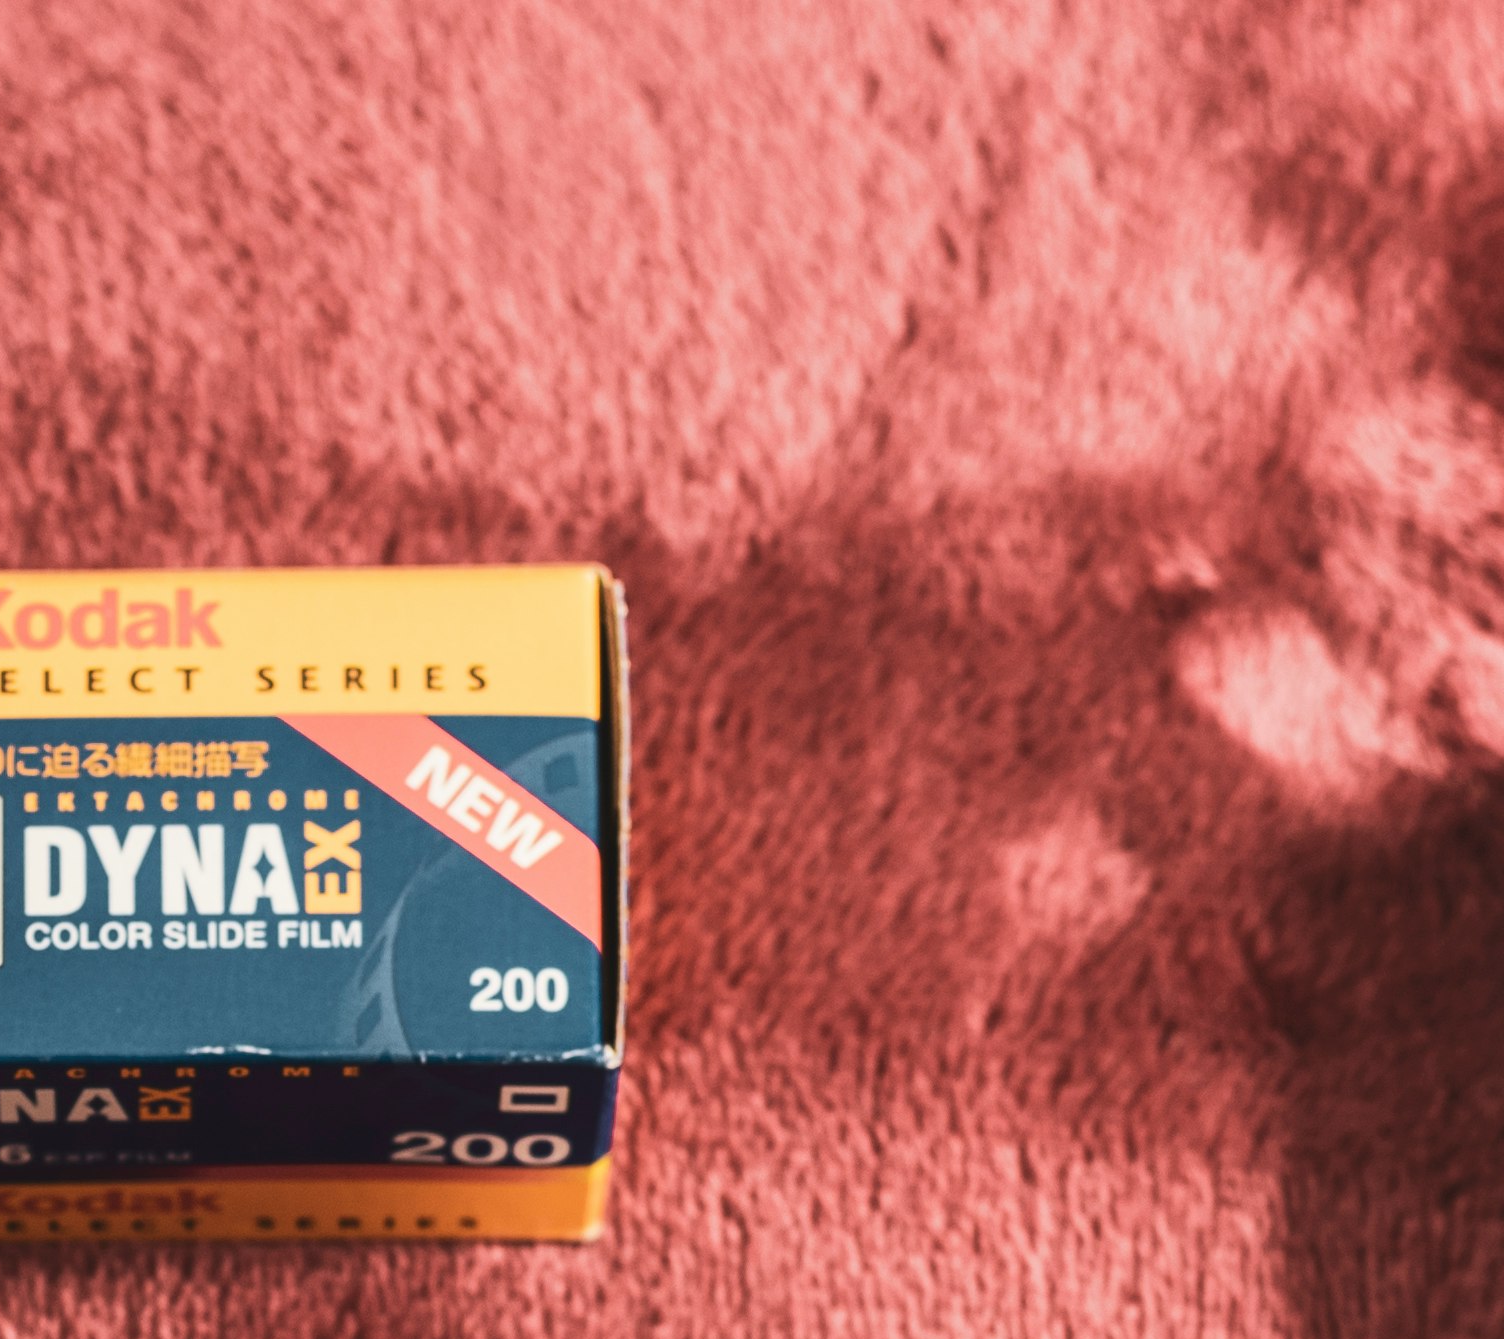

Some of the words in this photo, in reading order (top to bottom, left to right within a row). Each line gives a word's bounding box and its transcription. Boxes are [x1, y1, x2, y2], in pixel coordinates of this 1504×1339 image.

[257, 664, 489, 694] SERIES
[23, 790, 360, 813] EKTACHROME
[404, 745, 565, 871] NEW
[23, 823, 300, 917] DYNA
[304, 820, 362, 915] EX
[24, 919, 153, 951] COLOR
[162, 919, 268, 950] SLIDE
[278, 918, 363, 949] FILM
[468, 966, 570, 1012] 200
[138, 1085, 192, 1122] EX
[390, 1131, 571, 1166] 200
